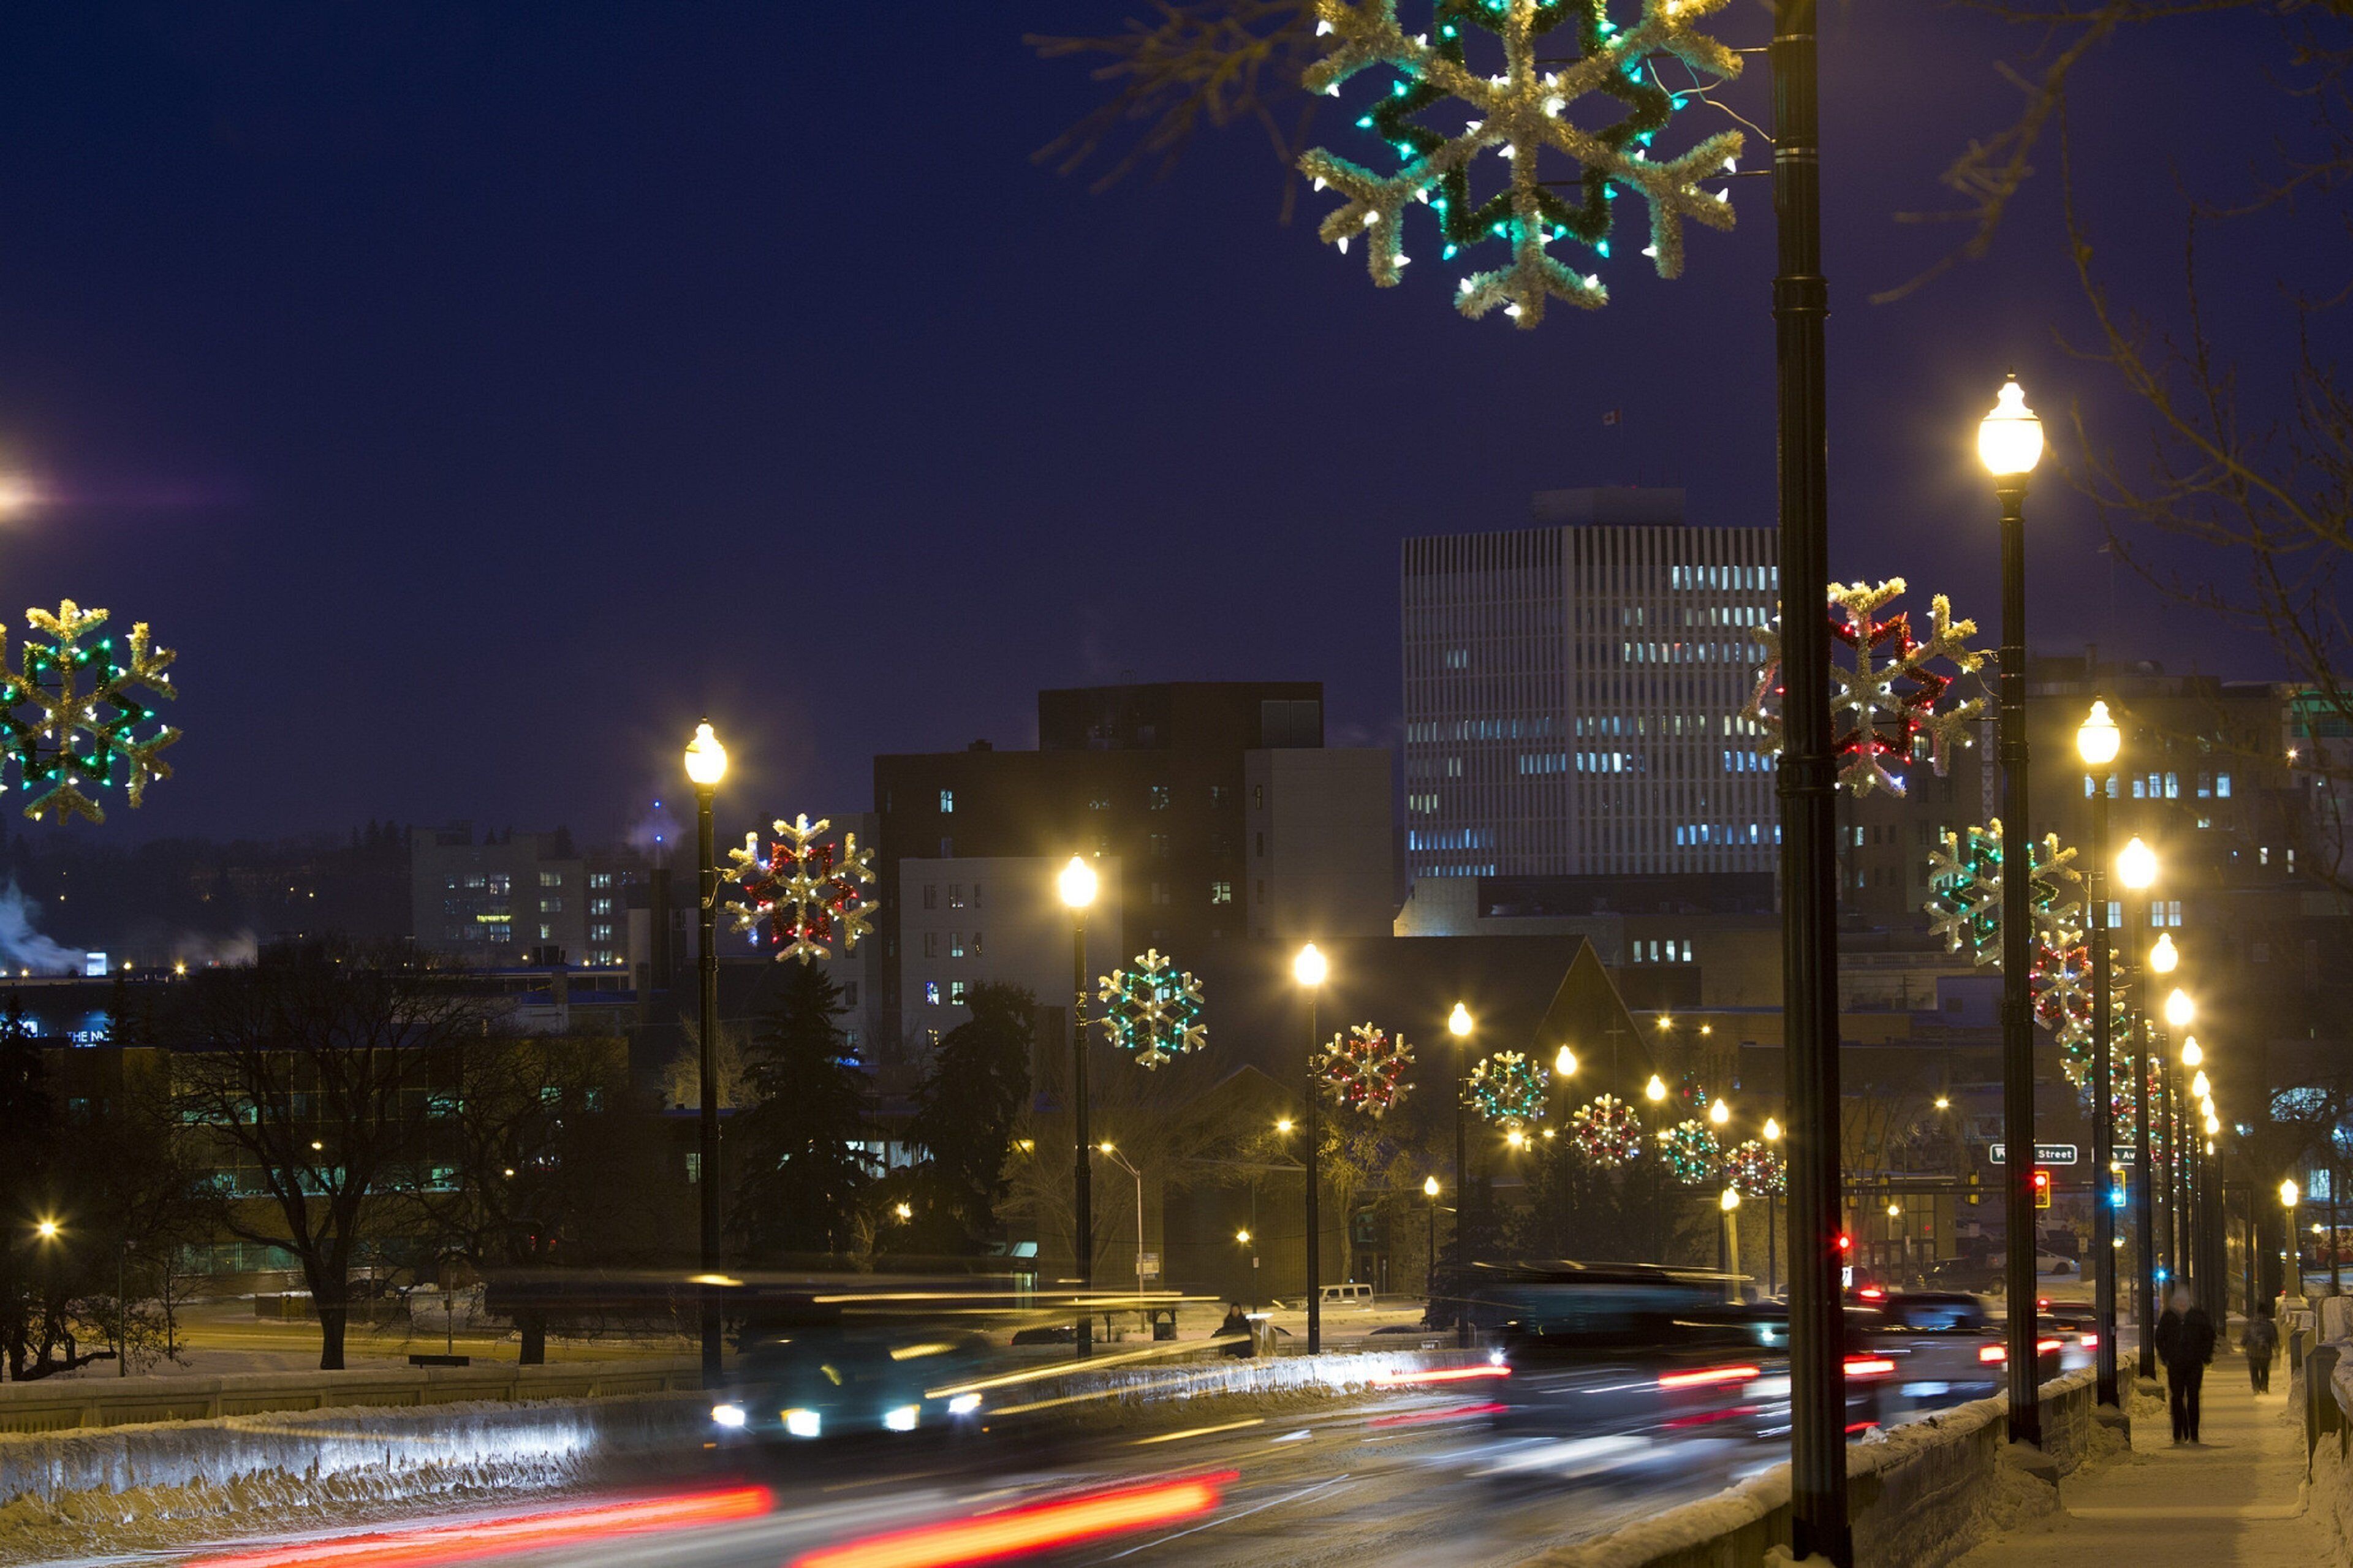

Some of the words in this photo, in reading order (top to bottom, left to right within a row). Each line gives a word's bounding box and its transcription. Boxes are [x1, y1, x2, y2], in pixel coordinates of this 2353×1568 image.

[66, 1031, 88, 1042] THE
[2038, 1149, 2072, 1159] Street
[2122, 1151, 2136, 1160] Av
